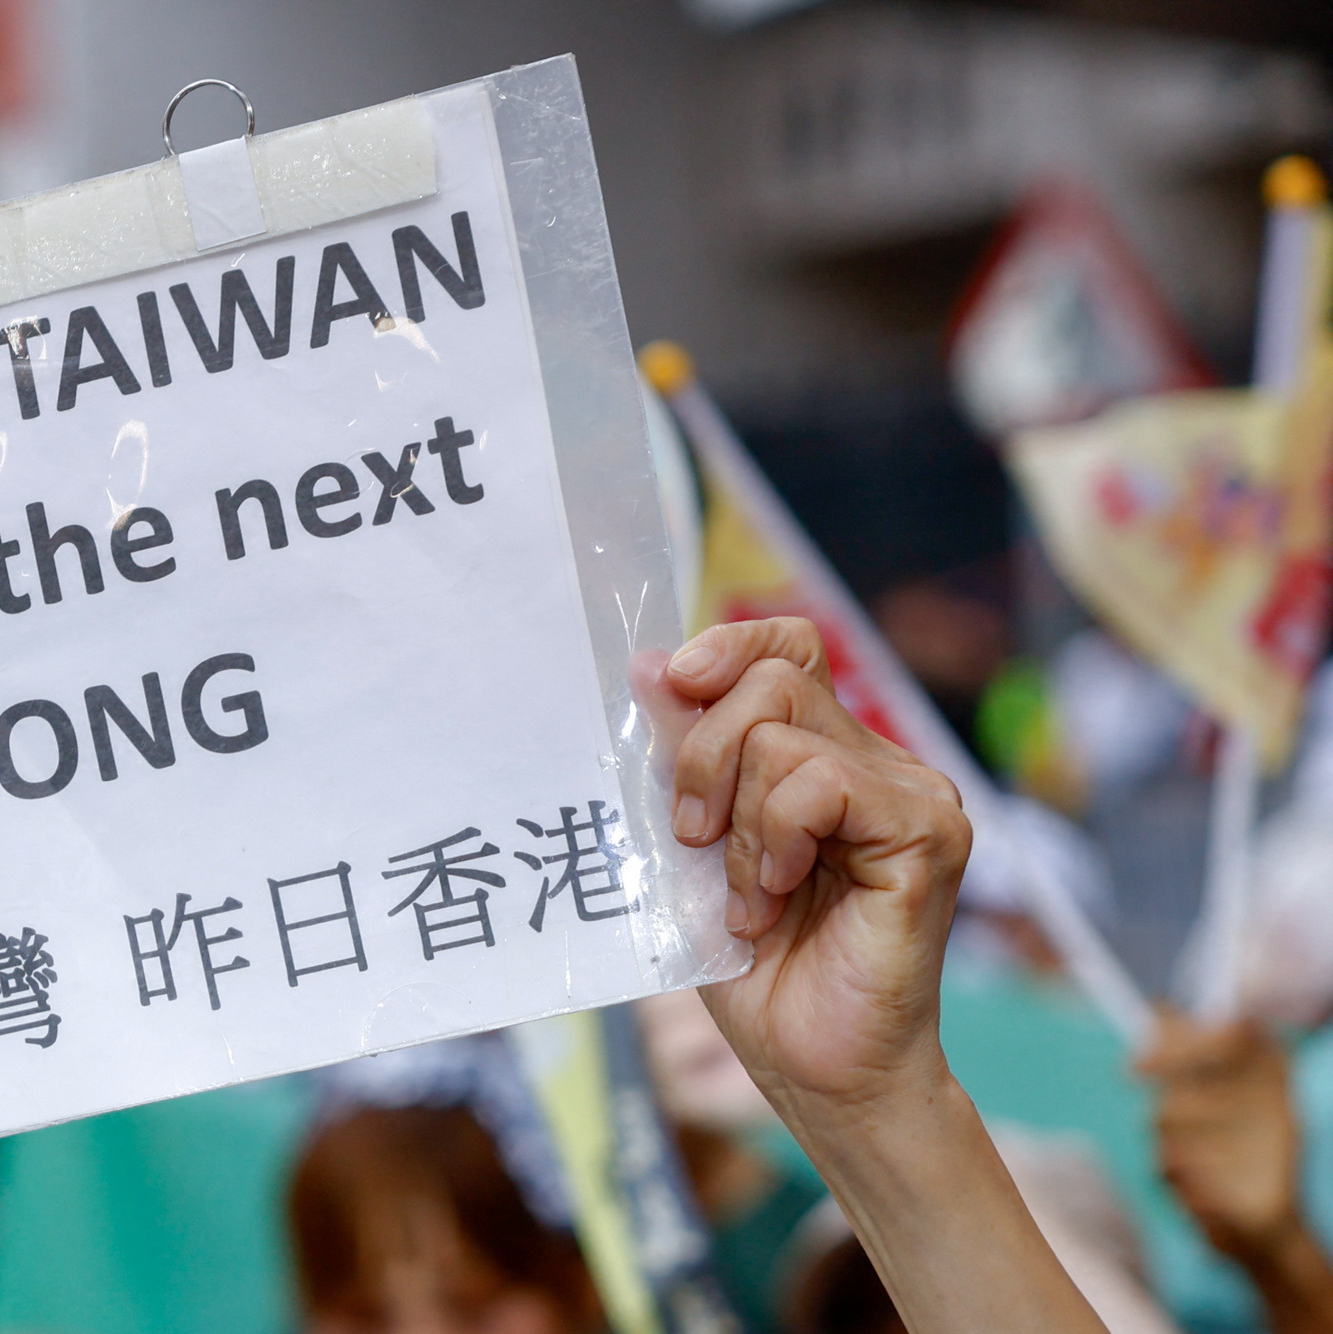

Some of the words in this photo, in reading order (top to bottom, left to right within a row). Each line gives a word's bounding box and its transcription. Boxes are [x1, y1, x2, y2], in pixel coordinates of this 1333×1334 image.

[214, 416, 485, 561] next
[123, 799, 641, 1012] 昨日香港
